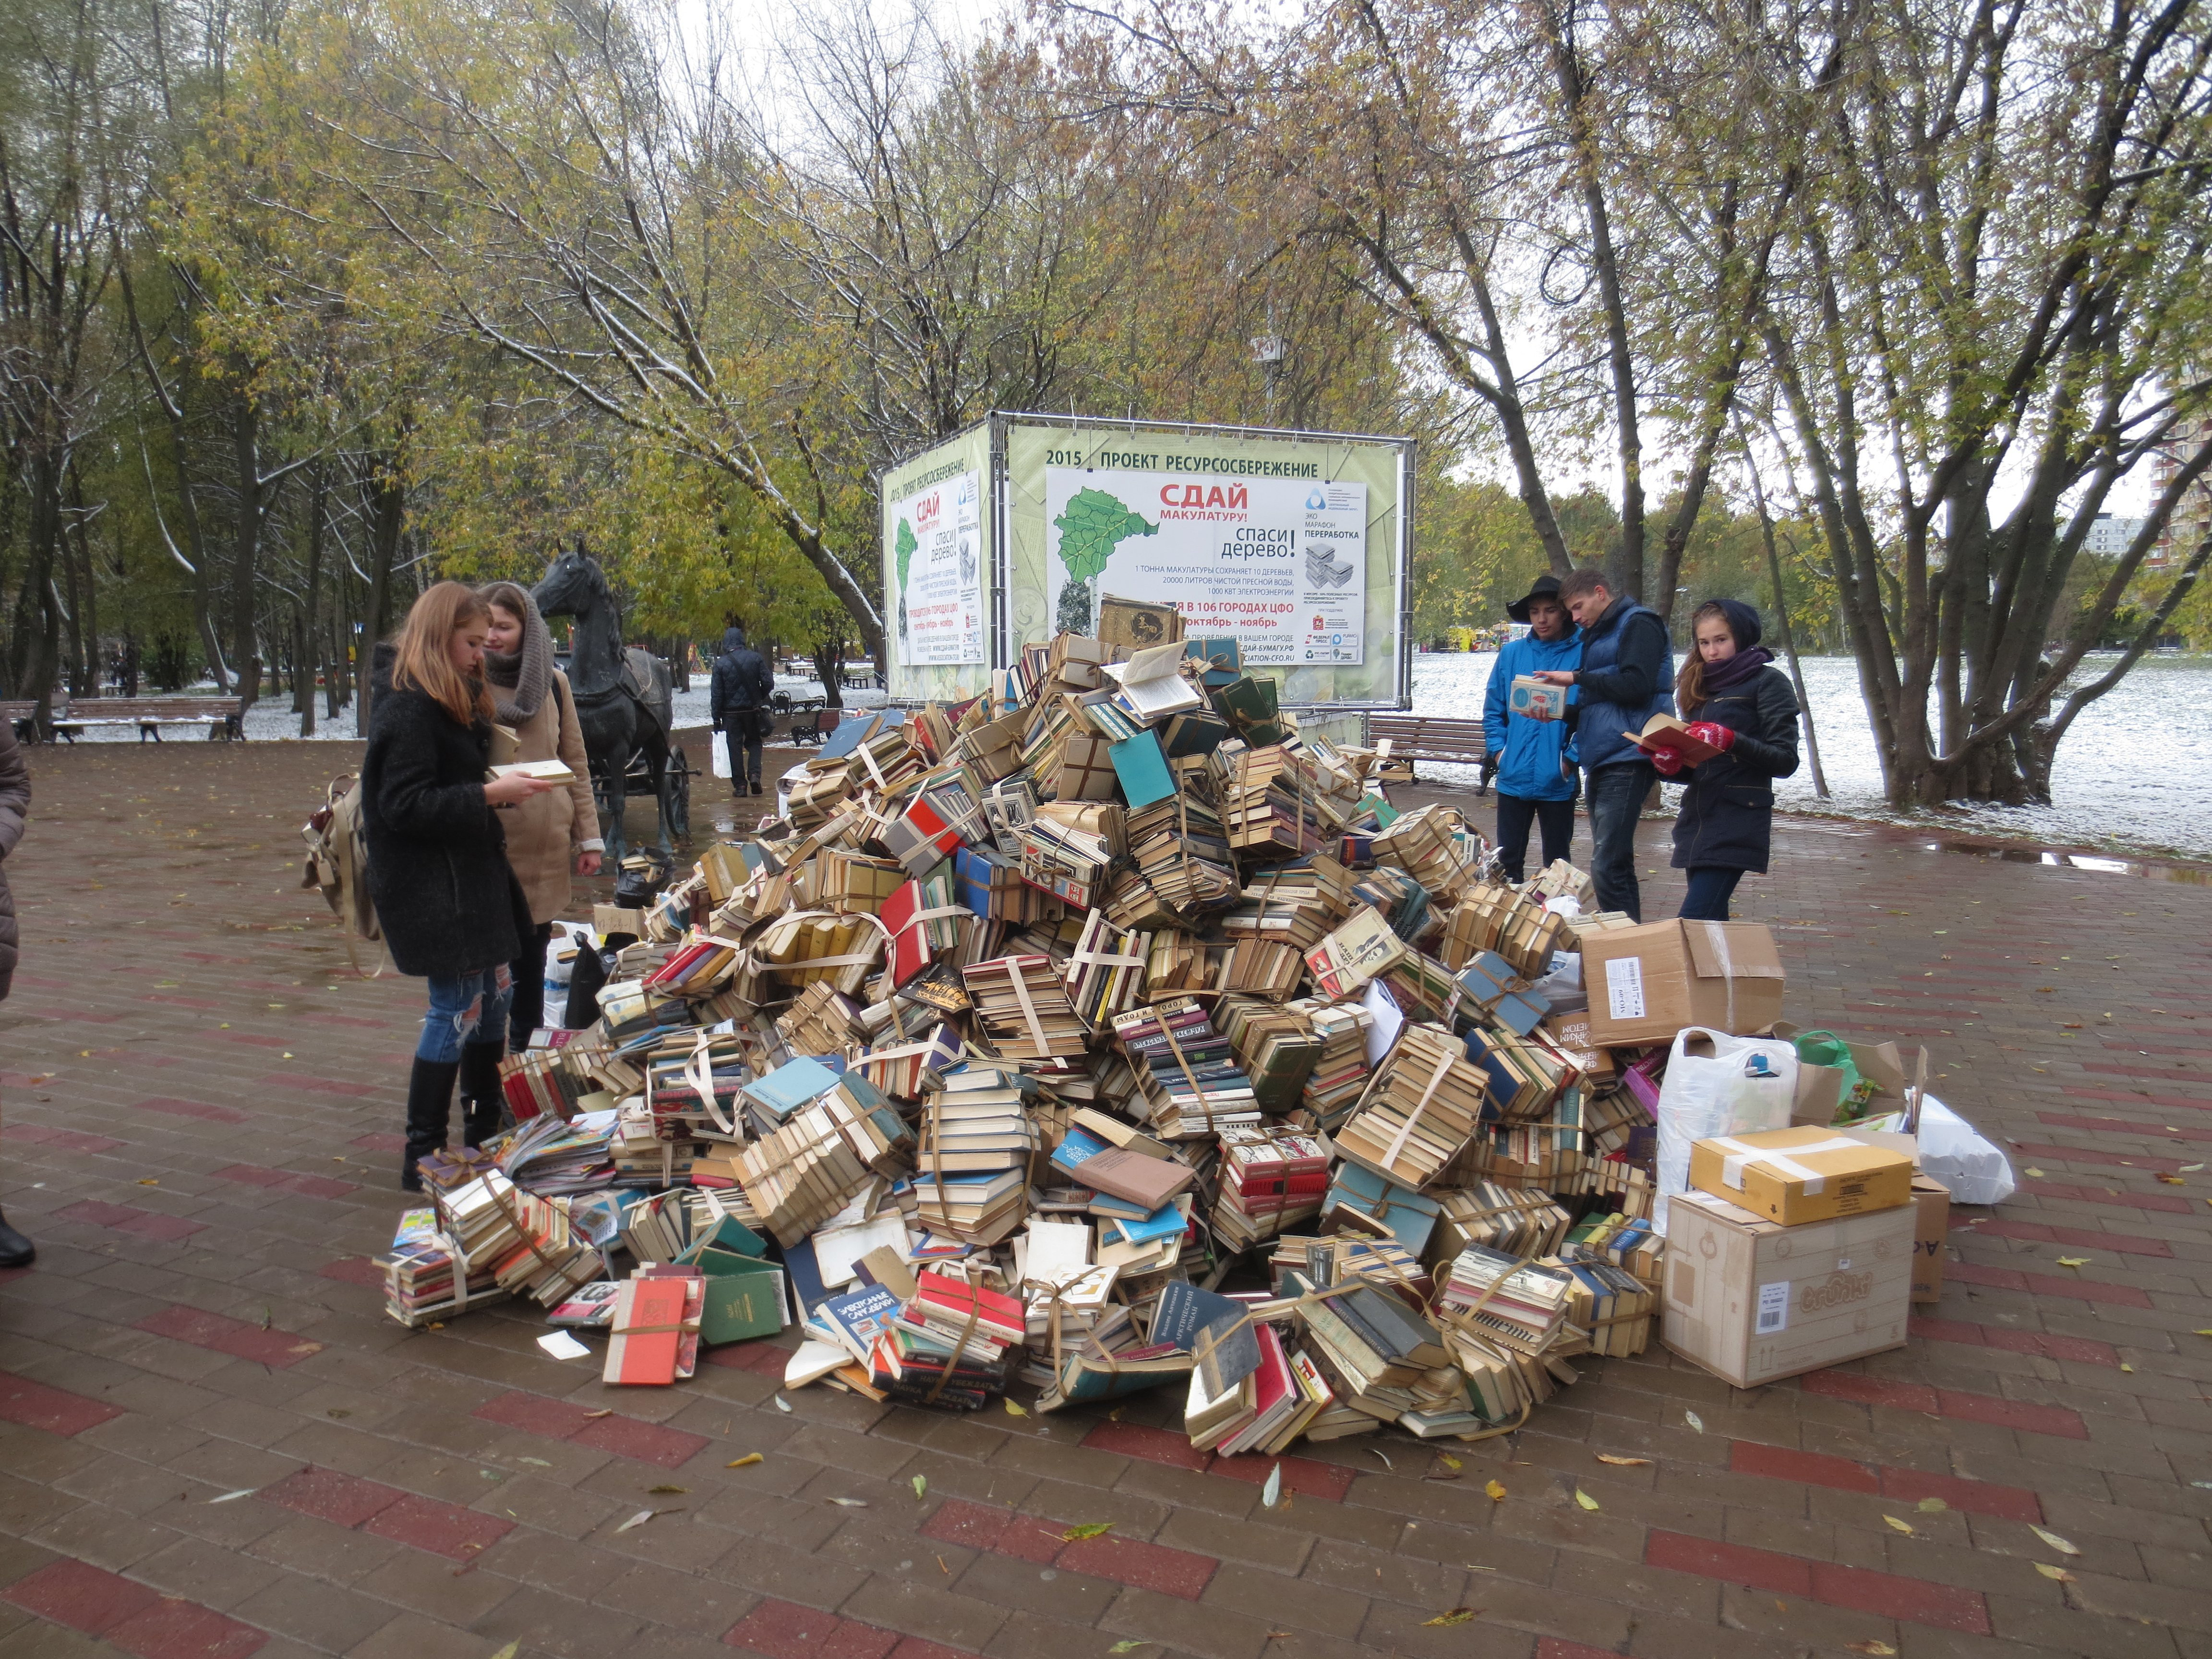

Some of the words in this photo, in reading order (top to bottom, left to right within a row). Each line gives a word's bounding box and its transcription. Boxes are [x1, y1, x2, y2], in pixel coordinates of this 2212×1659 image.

[1046, 450, 1082, 466] 2015
[1101, 452, 1159, 469] ПРОЕКТ
[1166, 456, 1318, 478] РЕСУРСОСБЕРЕЖЕНИЕ
[1160, 483, 1248, 509] СДАЙ
[917, 491, 939, 523] СДАЙ
[1160, 510, 1248, 522] МАКУЛАТУРУ!
[936, 529, 954, 546] спаси
[1236, 528, 1287, 542] спаси
[1305, 530, 1359, 539] ПЕРЕРАБОТКА
[1187, 602, 1194, 612] В
[1197, 602, 1216, 612] 106
[1219, 602, 1267, 615] ГОРОДАХ
[1270, 603, 1294, 615] ЦФО
[1187, 616, 1232, 629] октябрь
[1240, 617, 1277, 629] ноябрь
[1338, 941, 1354, 961] НАШ
[1116, 1012, 1141, 1023] ГОДЫ
[1562, 1022, 1590, 1034] ЛЕТОМ
[1133, 1033, 1170, 1050] АЛЕКСАНД
[837, 1290, 890, 1317] ЭЛЕКТРОННЫЕ
[847, 1297, 896, 1321] САМОДЕЛКИ
[1176, 1290, 1194, 1342] АРКТИЧЕСКИЙ
[1186, 1306, 1199, 1332] РОМАН
[951, 1378, 996, 1391] УБЕЖДАТЬ
